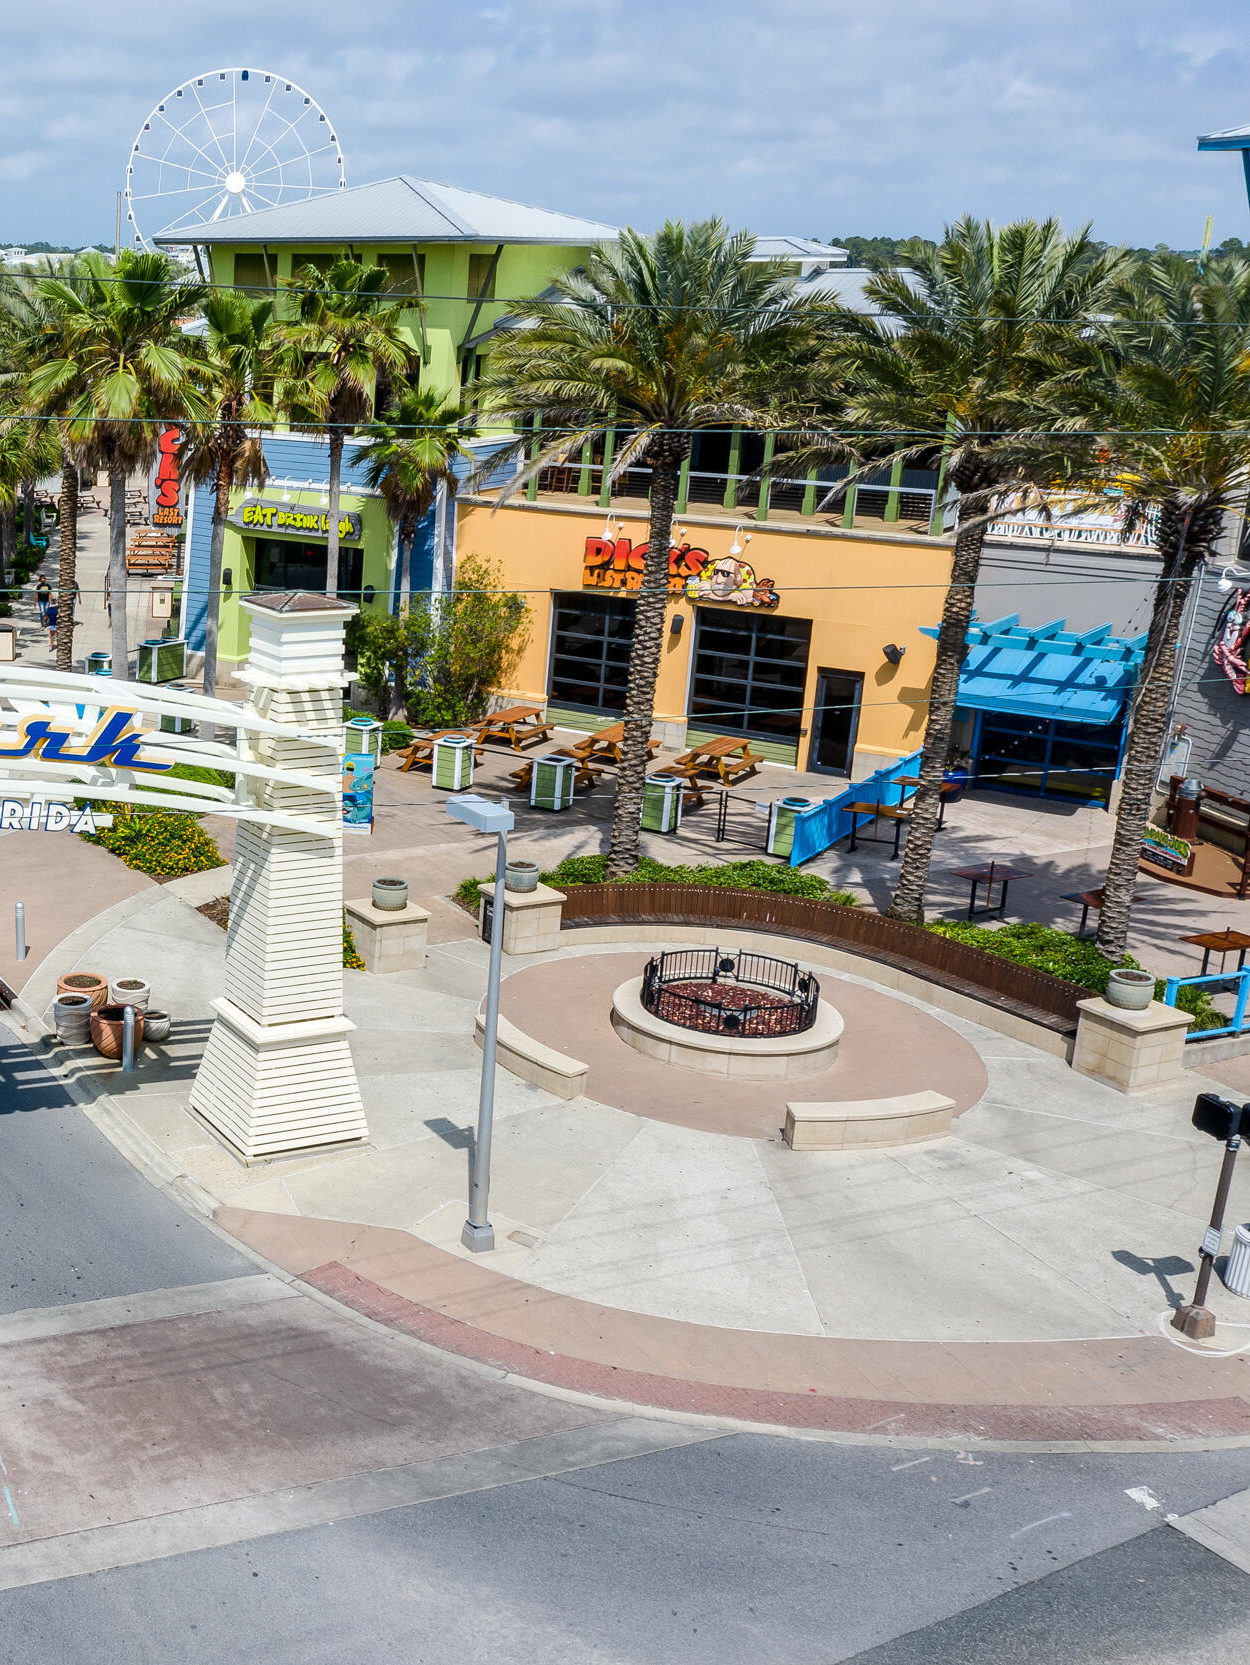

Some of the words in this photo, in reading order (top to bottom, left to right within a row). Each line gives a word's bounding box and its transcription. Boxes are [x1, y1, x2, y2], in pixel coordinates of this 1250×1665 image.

[158, 507, 180, 516] LAST
[153, 514, 183, 525] RESORT
[242, 504, 278, 527] EAT
[277, 511, 319, 530] DRINK
[320, 513, 354, 539] lagh
